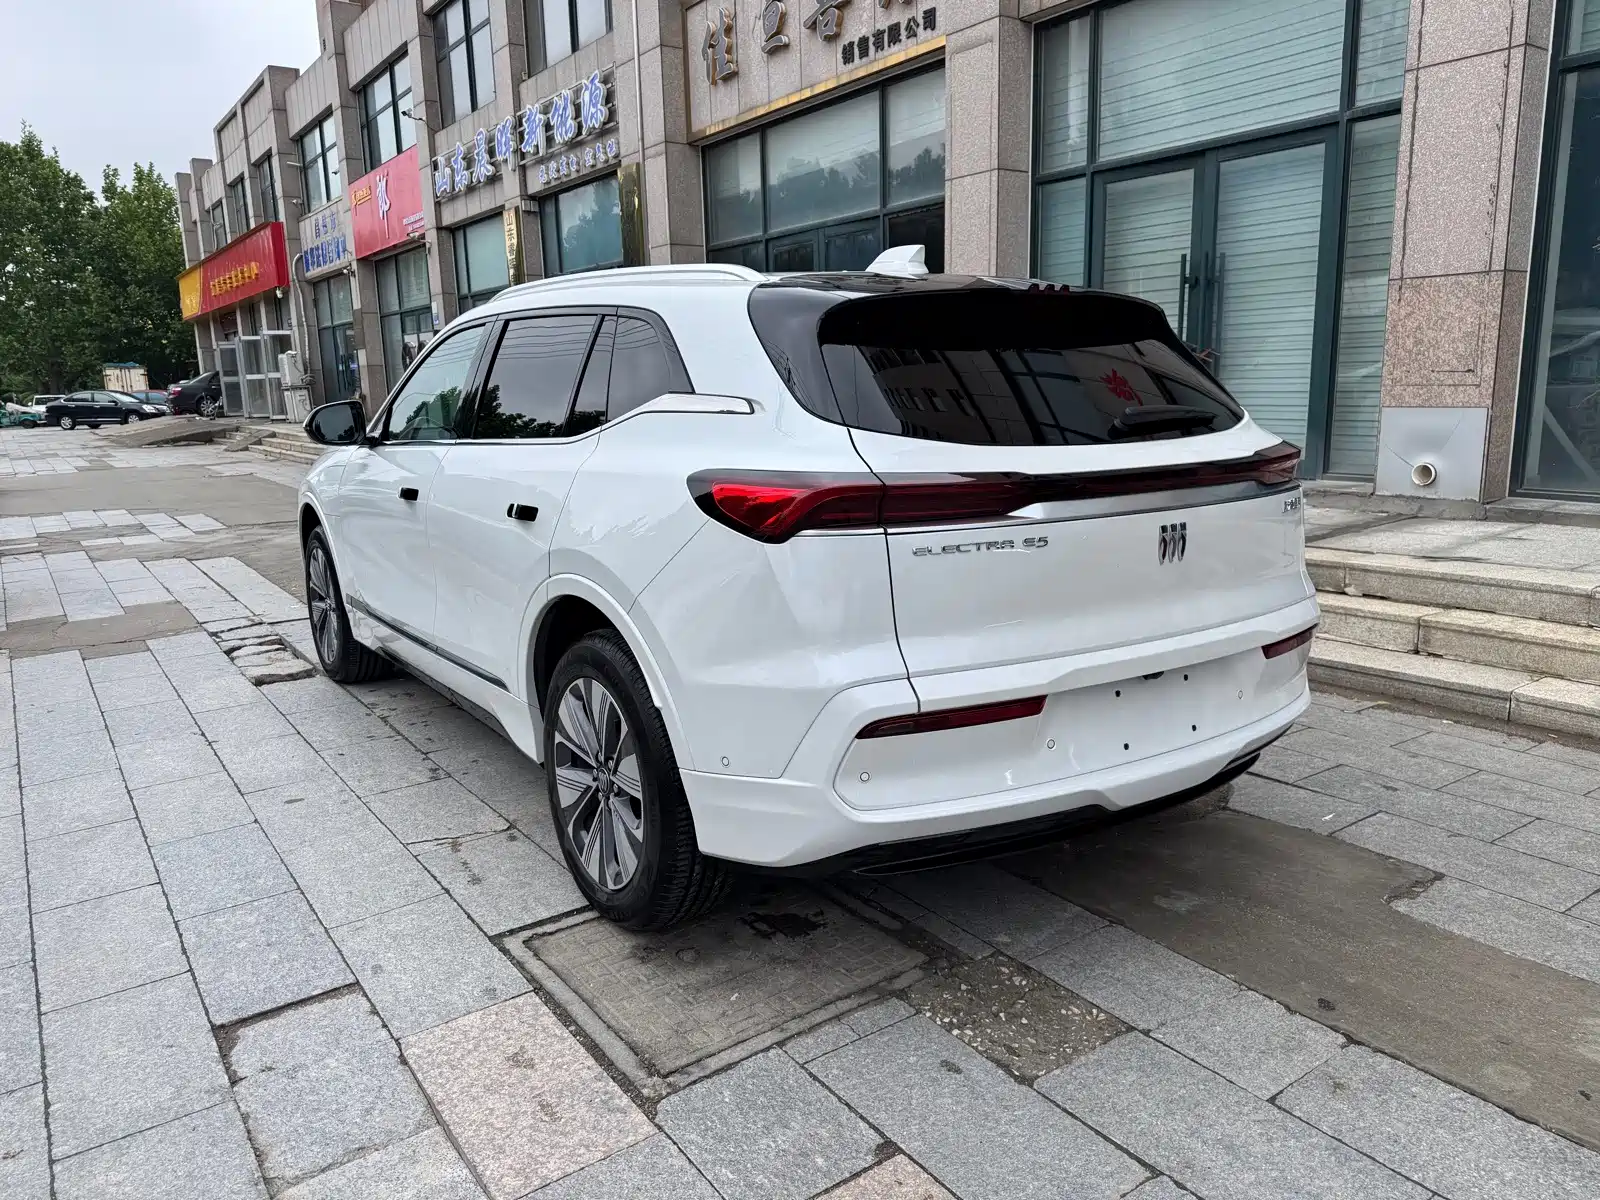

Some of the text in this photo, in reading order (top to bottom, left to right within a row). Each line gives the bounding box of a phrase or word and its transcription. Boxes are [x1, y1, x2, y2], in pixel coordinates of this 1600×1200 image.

[842, 7, 937, 66] 销售有限公司
[911, 536, 1049, 557] ELECTRA E5
